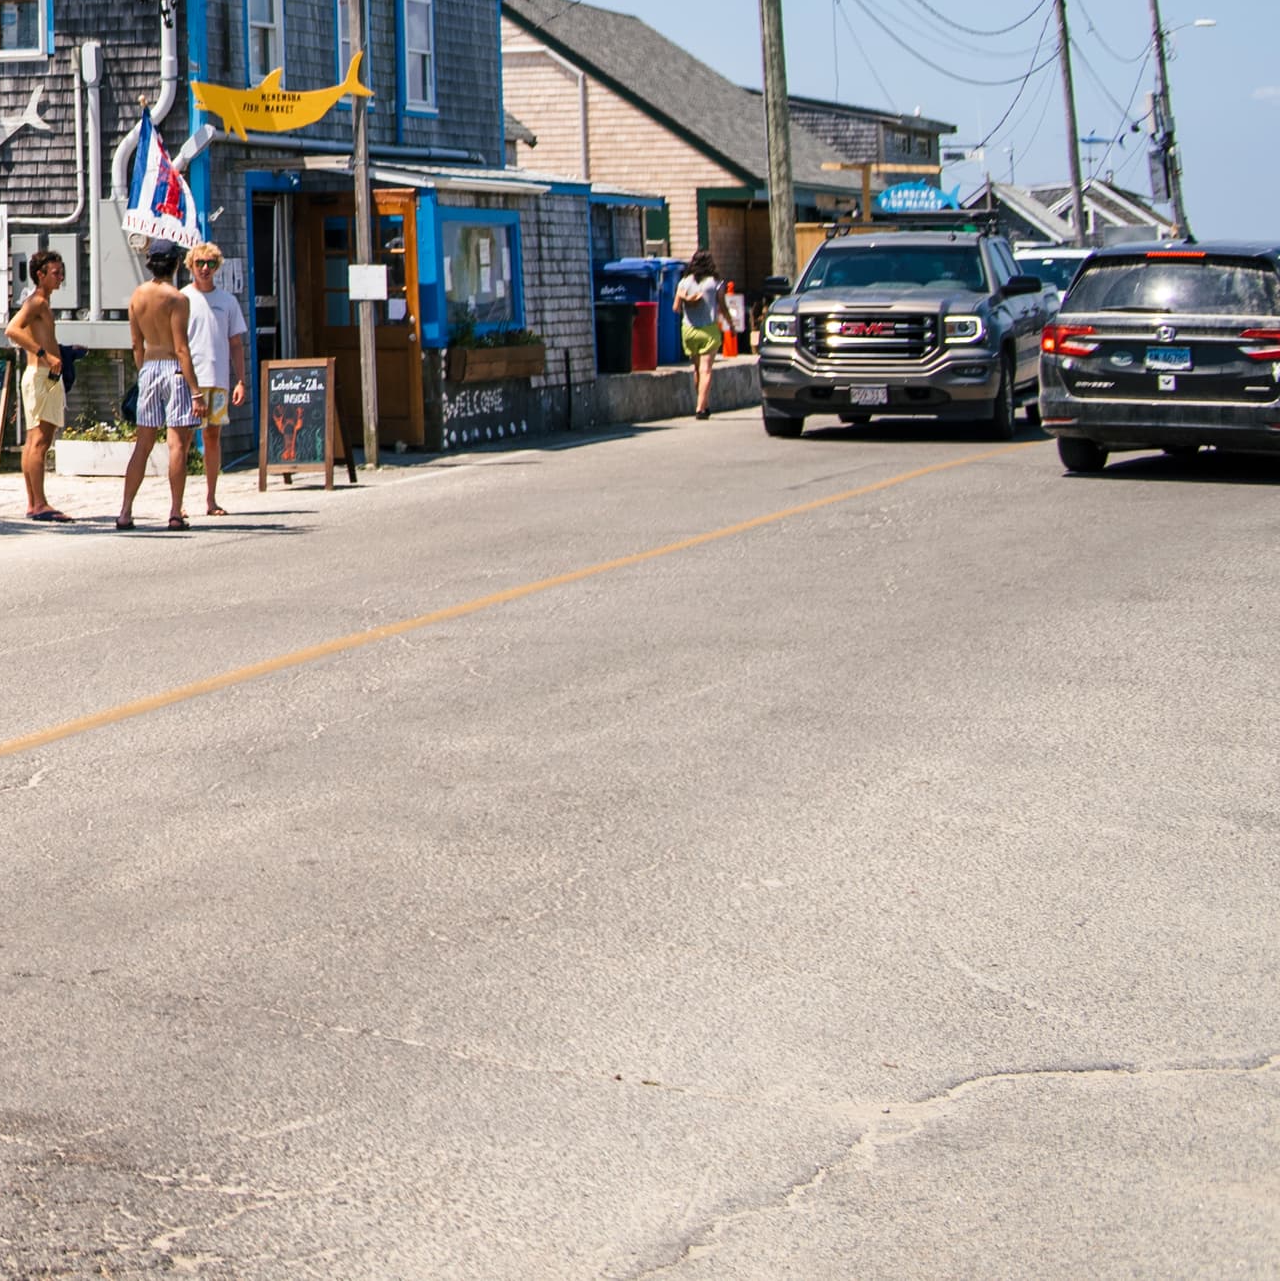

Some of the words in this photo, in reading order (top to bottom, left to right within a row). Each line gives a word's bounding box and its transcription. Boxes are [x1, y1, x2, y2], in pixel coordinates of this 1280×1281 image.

[261, 93, 301, 102] MENEMSHA
[243, 102, 259, 112] FISH
[265, 104, 294, 114] MARKET
[881, 197, 903, 208] FISH
[905, 199, 943, 209] MARKET
[841, 321, 895, 335] GMC
[443, 387, 504, 420] WELCOME
